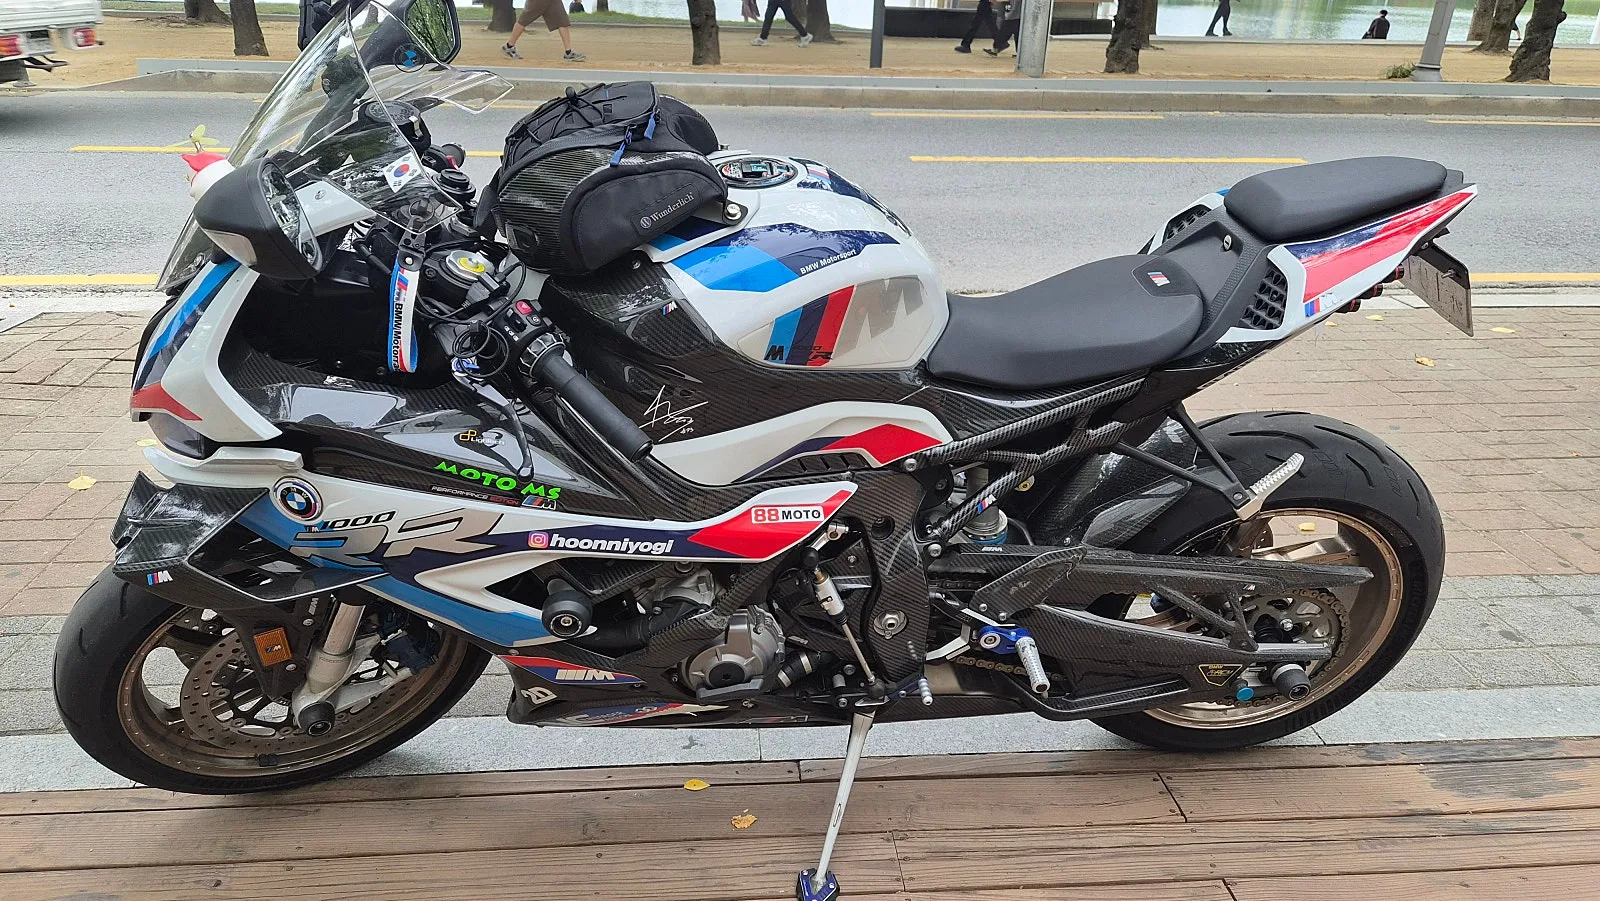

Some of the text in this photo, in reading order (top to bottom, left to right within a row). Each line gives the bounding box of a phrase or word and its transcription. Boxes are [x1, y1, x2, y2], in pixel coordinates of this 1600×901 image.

[650, 192, 695, 222] Wunderlich
[800, 248, 858, 275] BMW Motorsport
[393, 303, 404, 331] BMW
[431, 484, 490, 500] PERFORMANCE
[433, 461, 562, 500] MOTO MS
[320, 510, 397, 531] 1000
[753, 508, 821, 522] 88 MOTO
